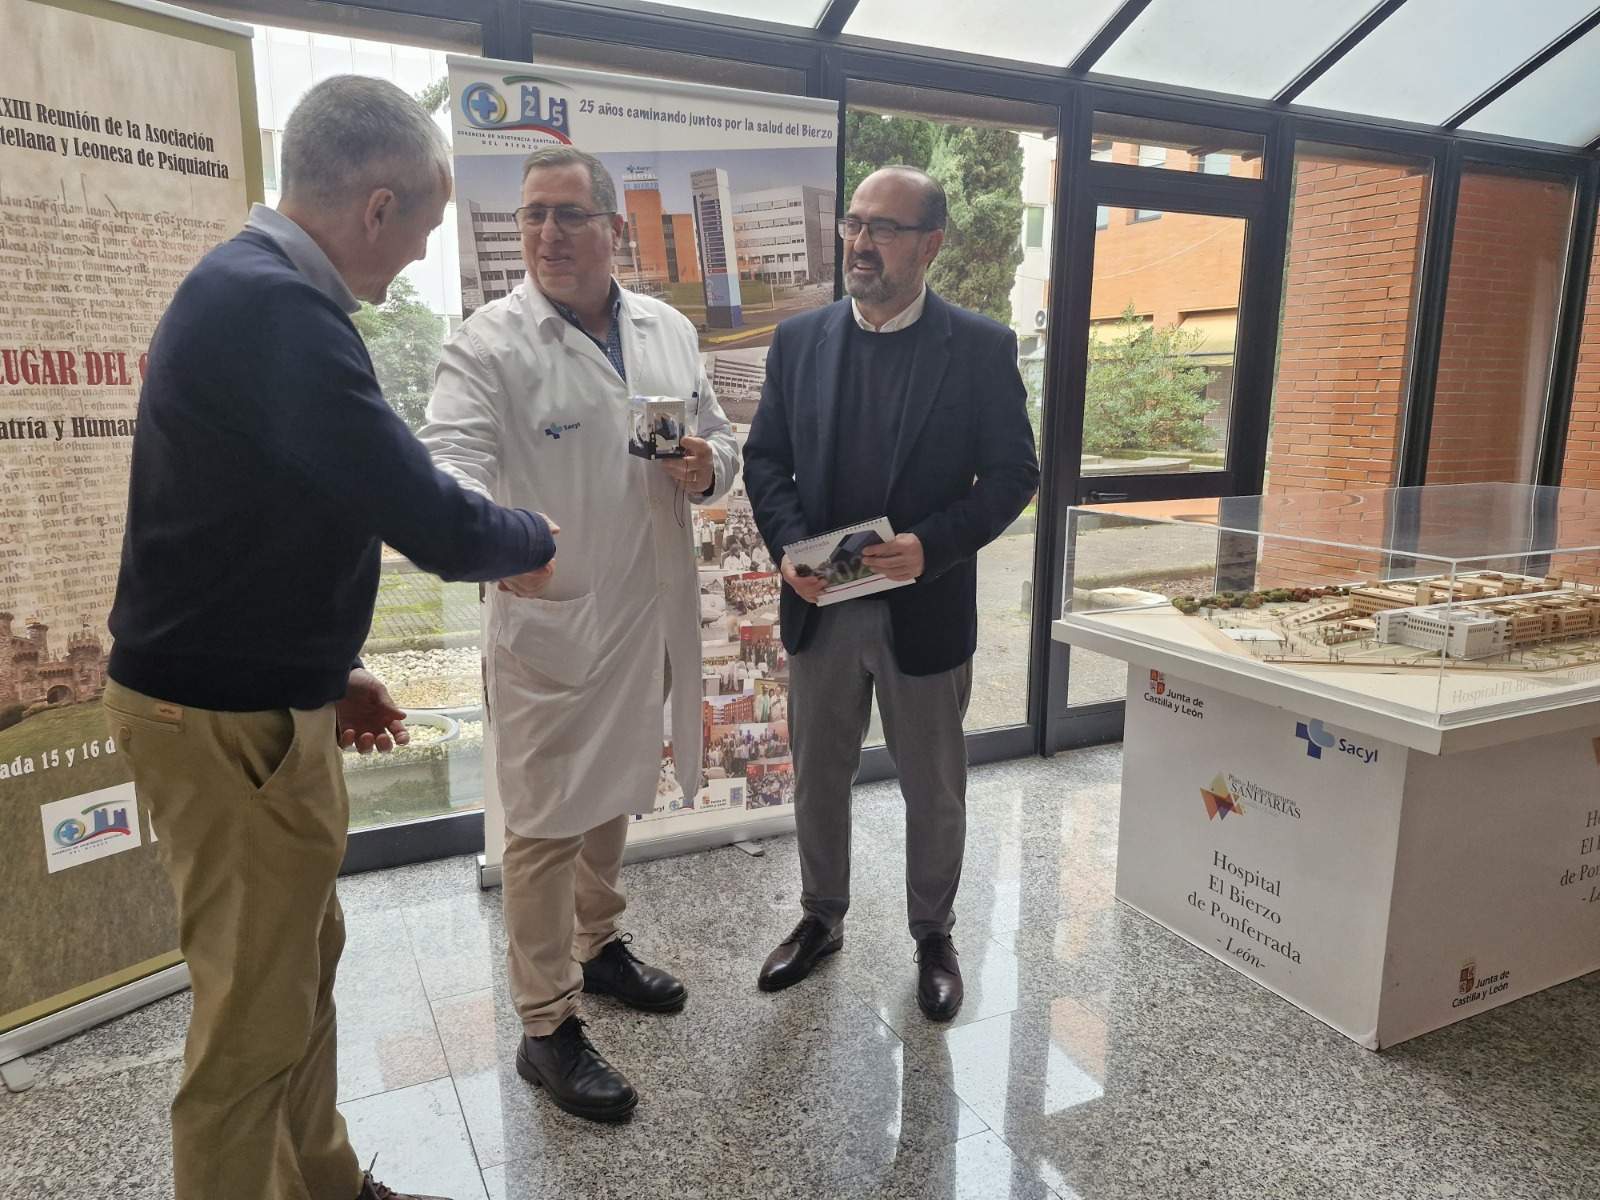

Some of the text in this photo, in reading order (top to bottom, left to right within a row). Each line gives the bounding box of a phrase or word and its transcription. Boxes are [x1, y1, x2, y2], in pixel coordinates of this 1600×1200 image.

[36, 103, 100, 133] Reunión
[105, 117, 123, 136] de
[126, 120, 141, 140] la
[145, 123, 214, 152] Asociación
[579, 99, 832, 139] 25 años caminando juntos por la salud del Bierzo
[60, 137, 69, 157] y
[73, 137, 133, 164] Leonesa
[137, 148, 154, 168] de
[158, 151, 229, 180] Psiquiatría
[0, 349, 78, 385] UGAR
[84, 351, 131, 385] DEL
[54, 420, 65, 441] y
[1144, 692, 1203, 719] Castilla y León
[1166, 689, 1204, 708] Junta de
[41, 748, 60, 769] 15
[65, 747, 75, 767] y
[81, 740, 100, 760] 16
[1338, 738, 1378, 763] Sacyl
[1231, 783, 1301, 819] SANITARIAS
[1581, 837, 1593, 855] El
[1213, 850, 1281, 897] Hospital
[1560, 869, 1576, 887] de
[1208, 874, 1281, 924] El Bierzo
[1187, 891, 1301, 964] de Ponferrada
[1475, 970, 1510, 989] Junta de
[1452, 982, 1509, 1008] Castilla y León
